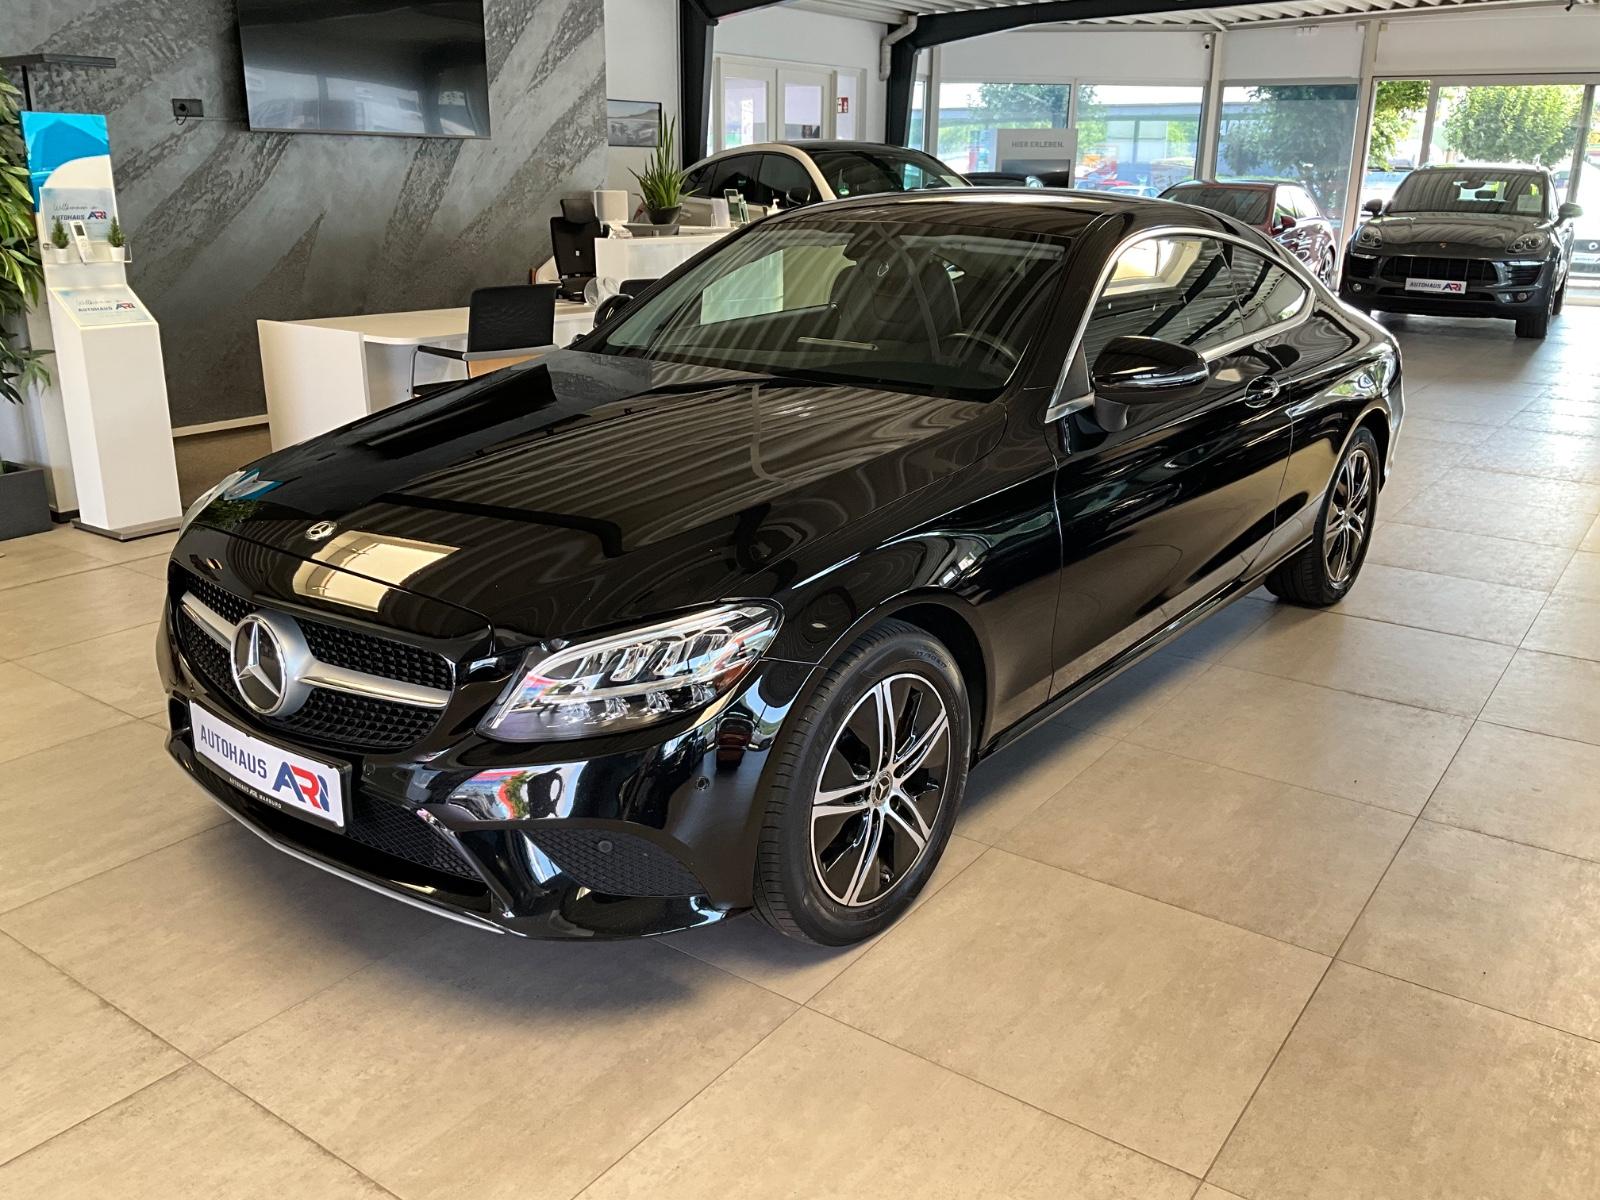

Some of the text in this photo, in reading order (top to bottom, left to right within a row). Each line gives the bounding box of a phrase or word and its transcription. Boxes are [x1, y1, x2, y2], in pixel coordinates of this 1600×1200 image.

[1409, 281, 1462, 291] AUTOHAUS ARI
[200, 724, 331, 813] AUTOHAUS ARI
